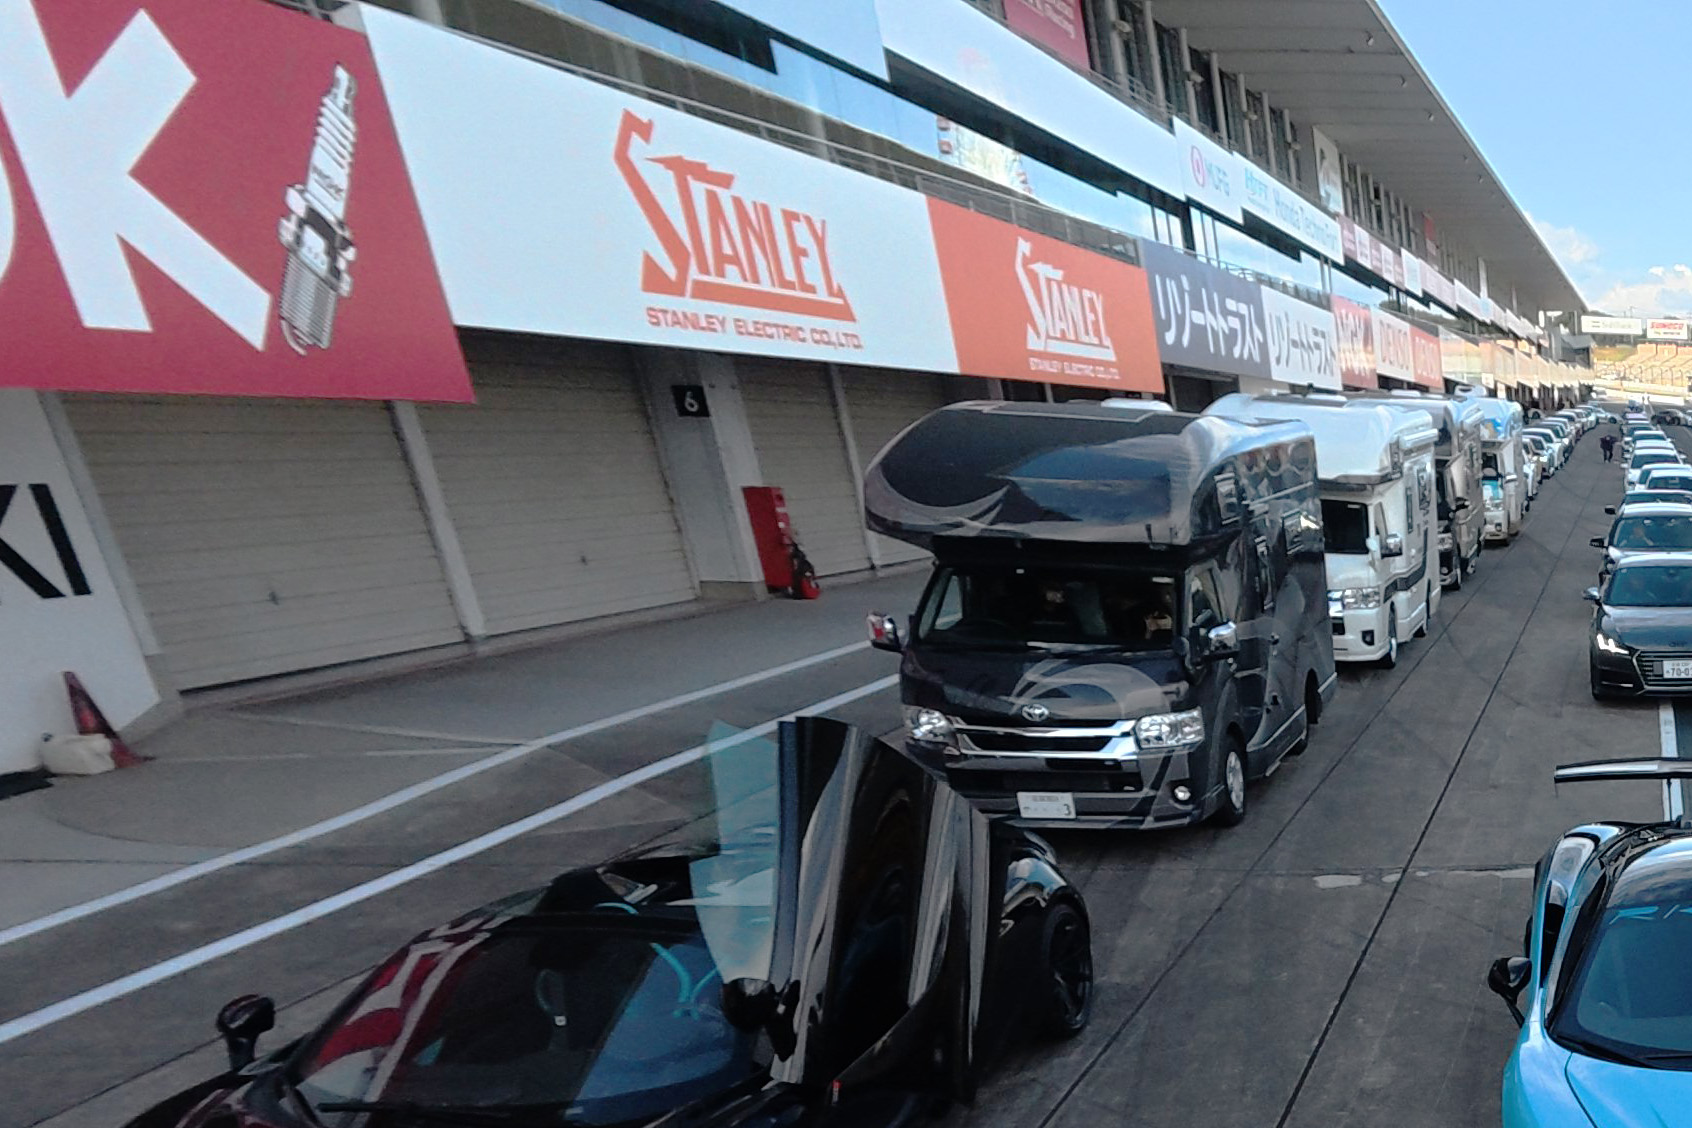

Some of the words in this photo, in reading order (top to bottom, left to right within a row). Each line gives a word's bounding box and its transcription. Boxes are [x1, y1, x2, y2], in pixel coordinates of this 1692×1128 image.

[0, 0, 271, 351] K
[614, 108, 857, 322] STANLEY
[645, 306, 728, 334] STANLEY
[732, 317, 807, 343] ELECTRIC
[1015, 236, 1117, 362] STANLEY
[1155, 273, 1263, 364] リゾートトラスト
[685, 390, 700, 412] 6
